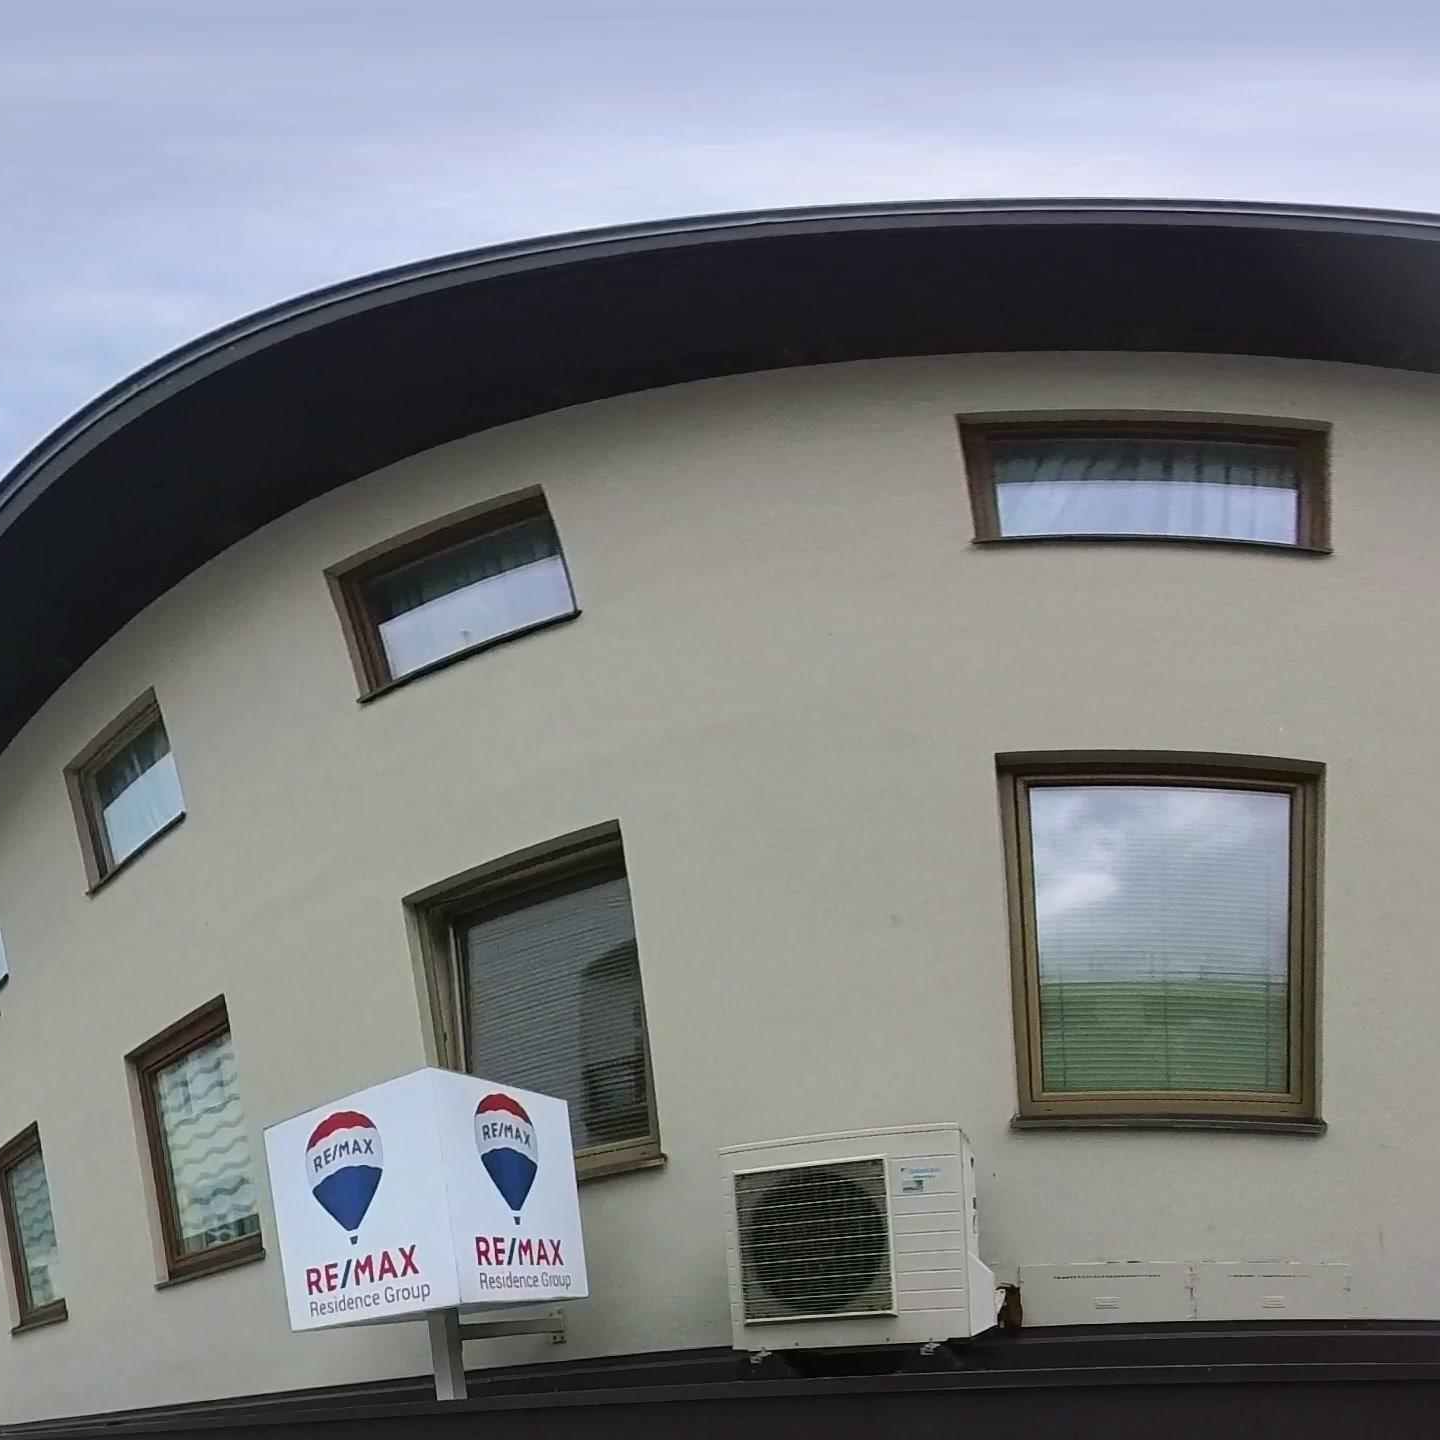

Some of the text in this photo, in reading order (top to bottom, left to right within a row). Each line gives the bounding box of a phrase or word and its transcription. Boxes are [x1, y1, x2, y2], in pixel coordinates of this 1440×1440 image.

[482, 1121, 532, 1148] RE/MAX
[313, 1138, 375, 1173] RE/MAX
[475, 1236, 565, 1267] RE/MAX
[306, 1244, 421, 1297] RE/MAX
[479, 1272, 572, 1291] Residence Group
[309, 1281, 432, 1317] Residence Group
